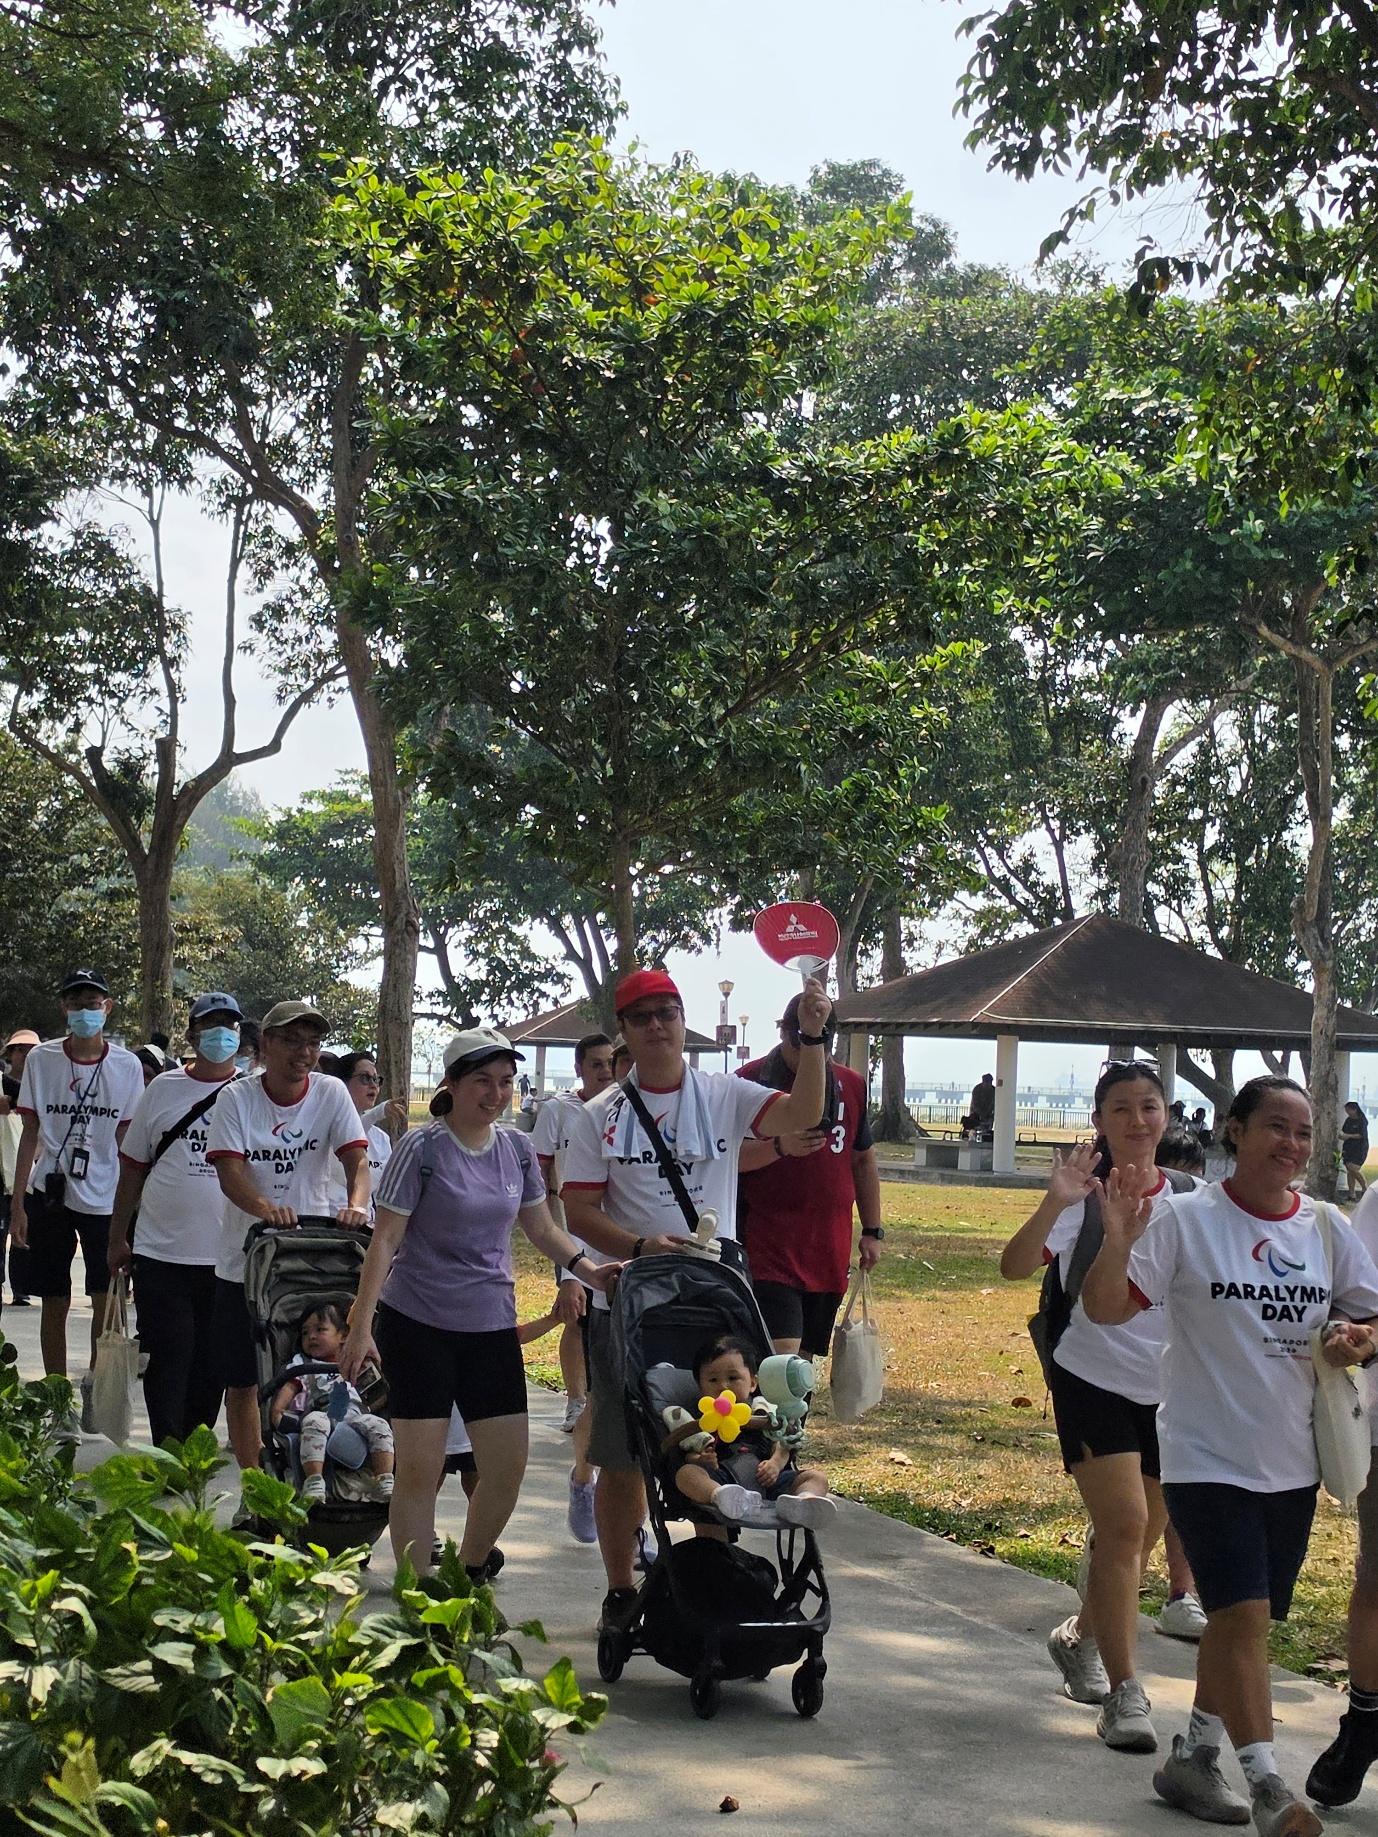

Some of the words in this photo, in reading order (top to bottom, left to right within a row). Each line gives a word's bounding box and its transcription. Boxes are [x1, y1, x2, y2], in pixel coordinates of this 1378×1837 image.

[46, 1104, 119, 1119] PARALYMPIC
[1210, 1282, 1330, 1305] PARALYMP
[1261, 1303, 1308, 1323] DAY
